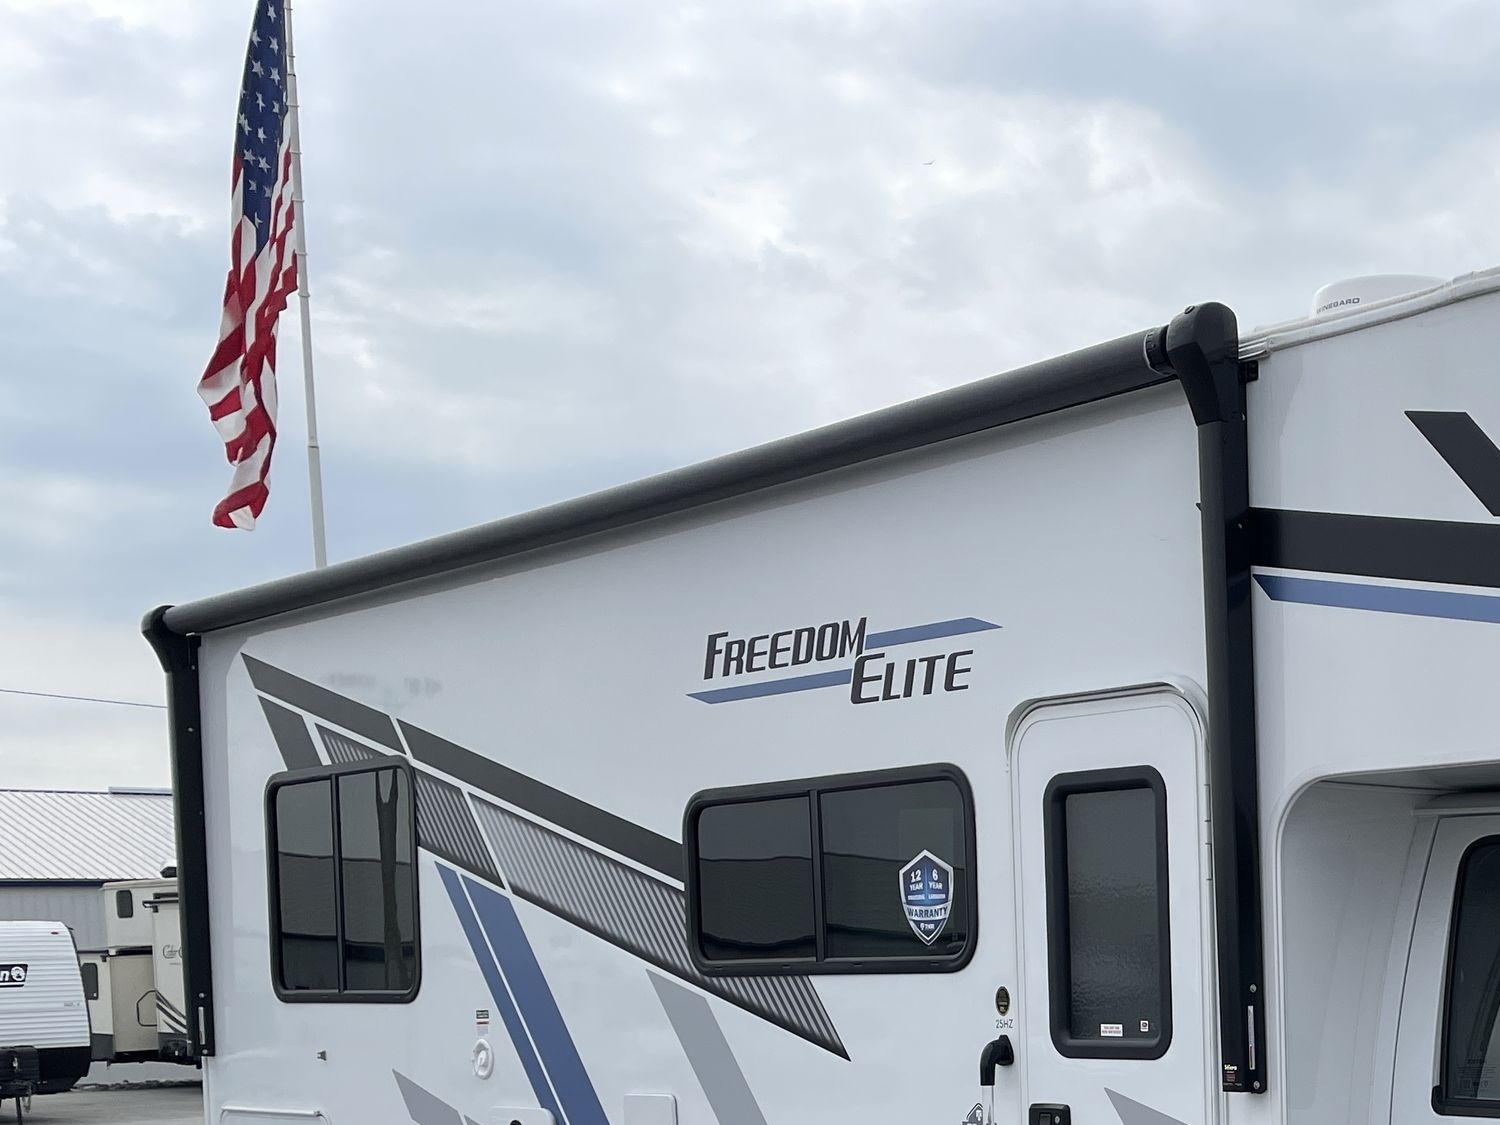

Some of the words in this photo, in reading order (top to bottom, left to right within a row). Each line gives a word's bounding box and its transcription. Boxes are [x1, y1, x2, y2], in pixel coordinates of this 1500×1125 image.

[703, 617, 867, 680] FREEDOM
[850, 649, 974, 705] ELITE
[910, 869, 922, 882] 12
[932, 869, 938, 881] 6
[909, 882, 923, 891] YEAR
[929, 881, 943, 890] YEAR
[907, 906, 948, 918] WARRANTY
